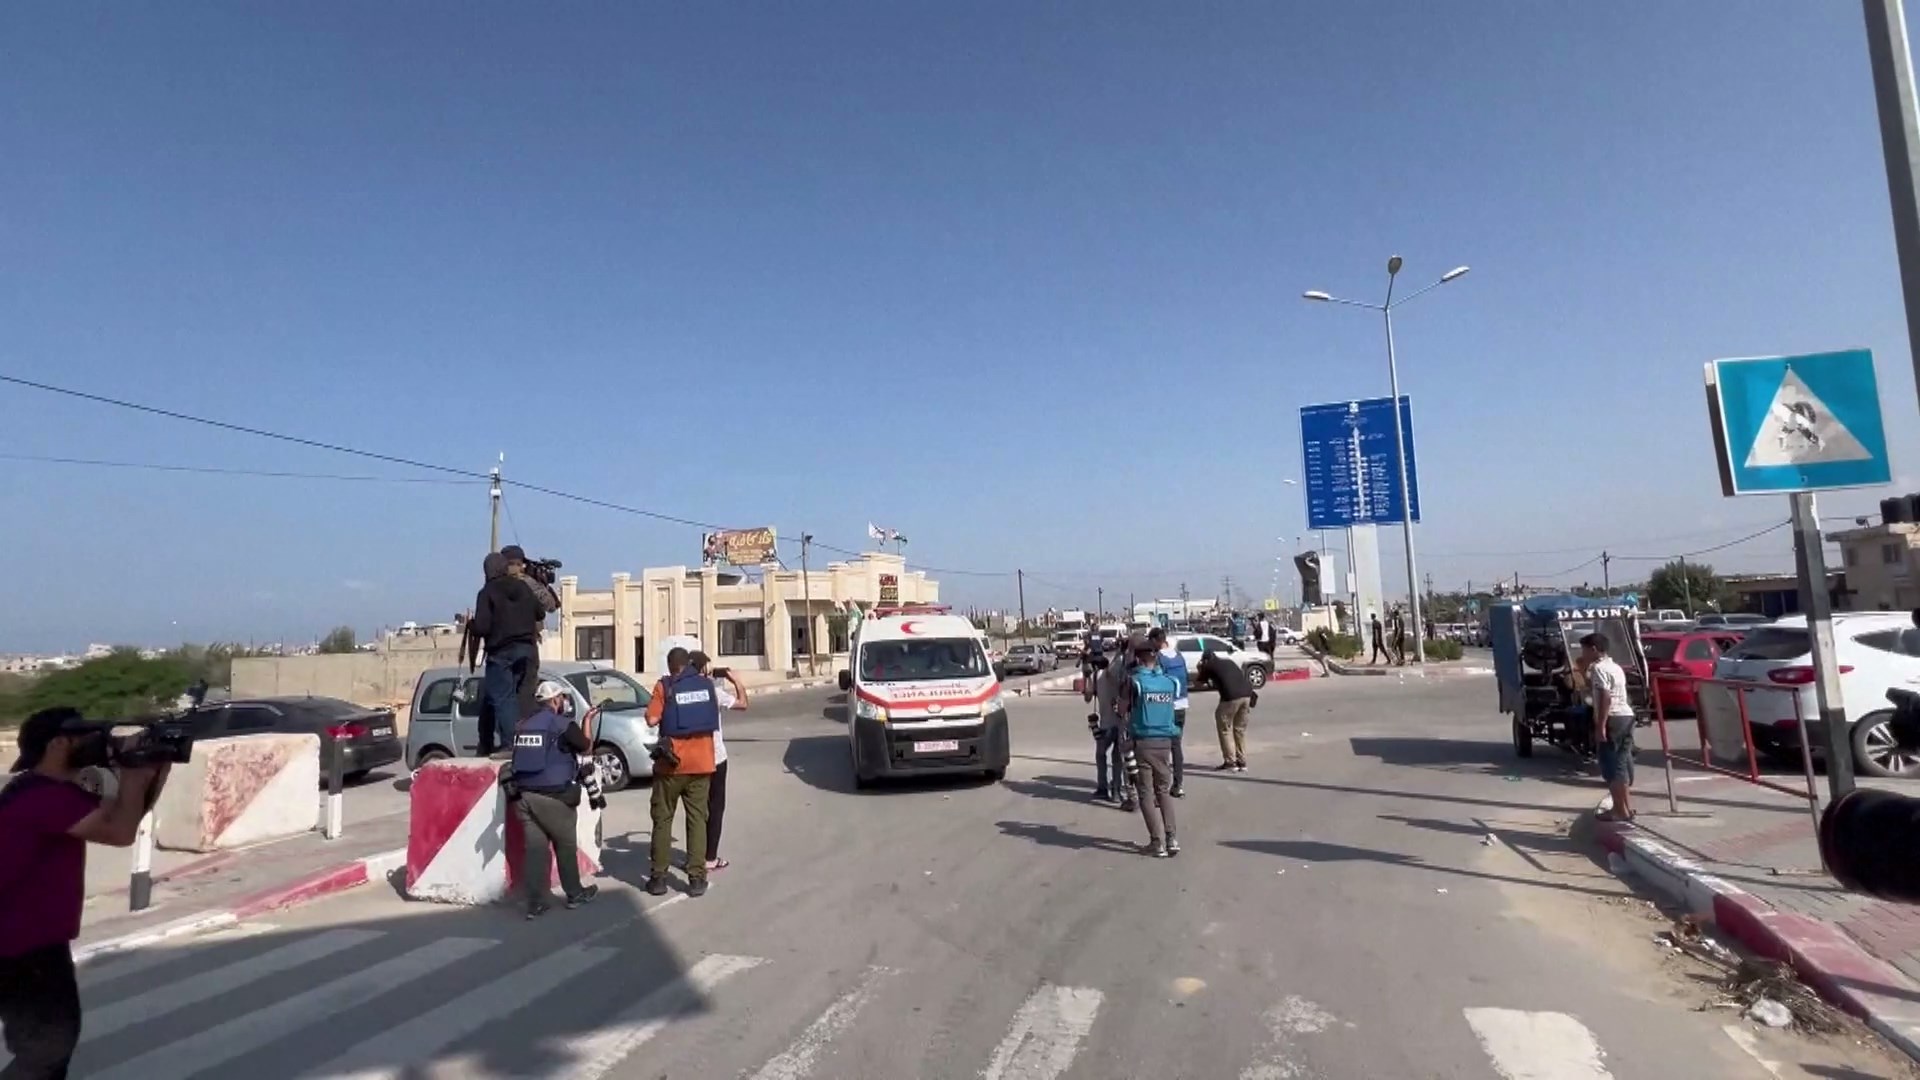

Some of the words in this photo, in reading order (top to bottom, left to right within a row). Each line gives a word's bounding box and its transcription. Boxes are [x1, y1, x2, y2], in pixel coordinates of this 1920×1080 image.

[1557, 608, 1621, 619] DAYUN
[677, 691, 709, 702] PRESS
[1146, 692, 1171, 703] PRESS
[515, 736, 541, 745] RESS
